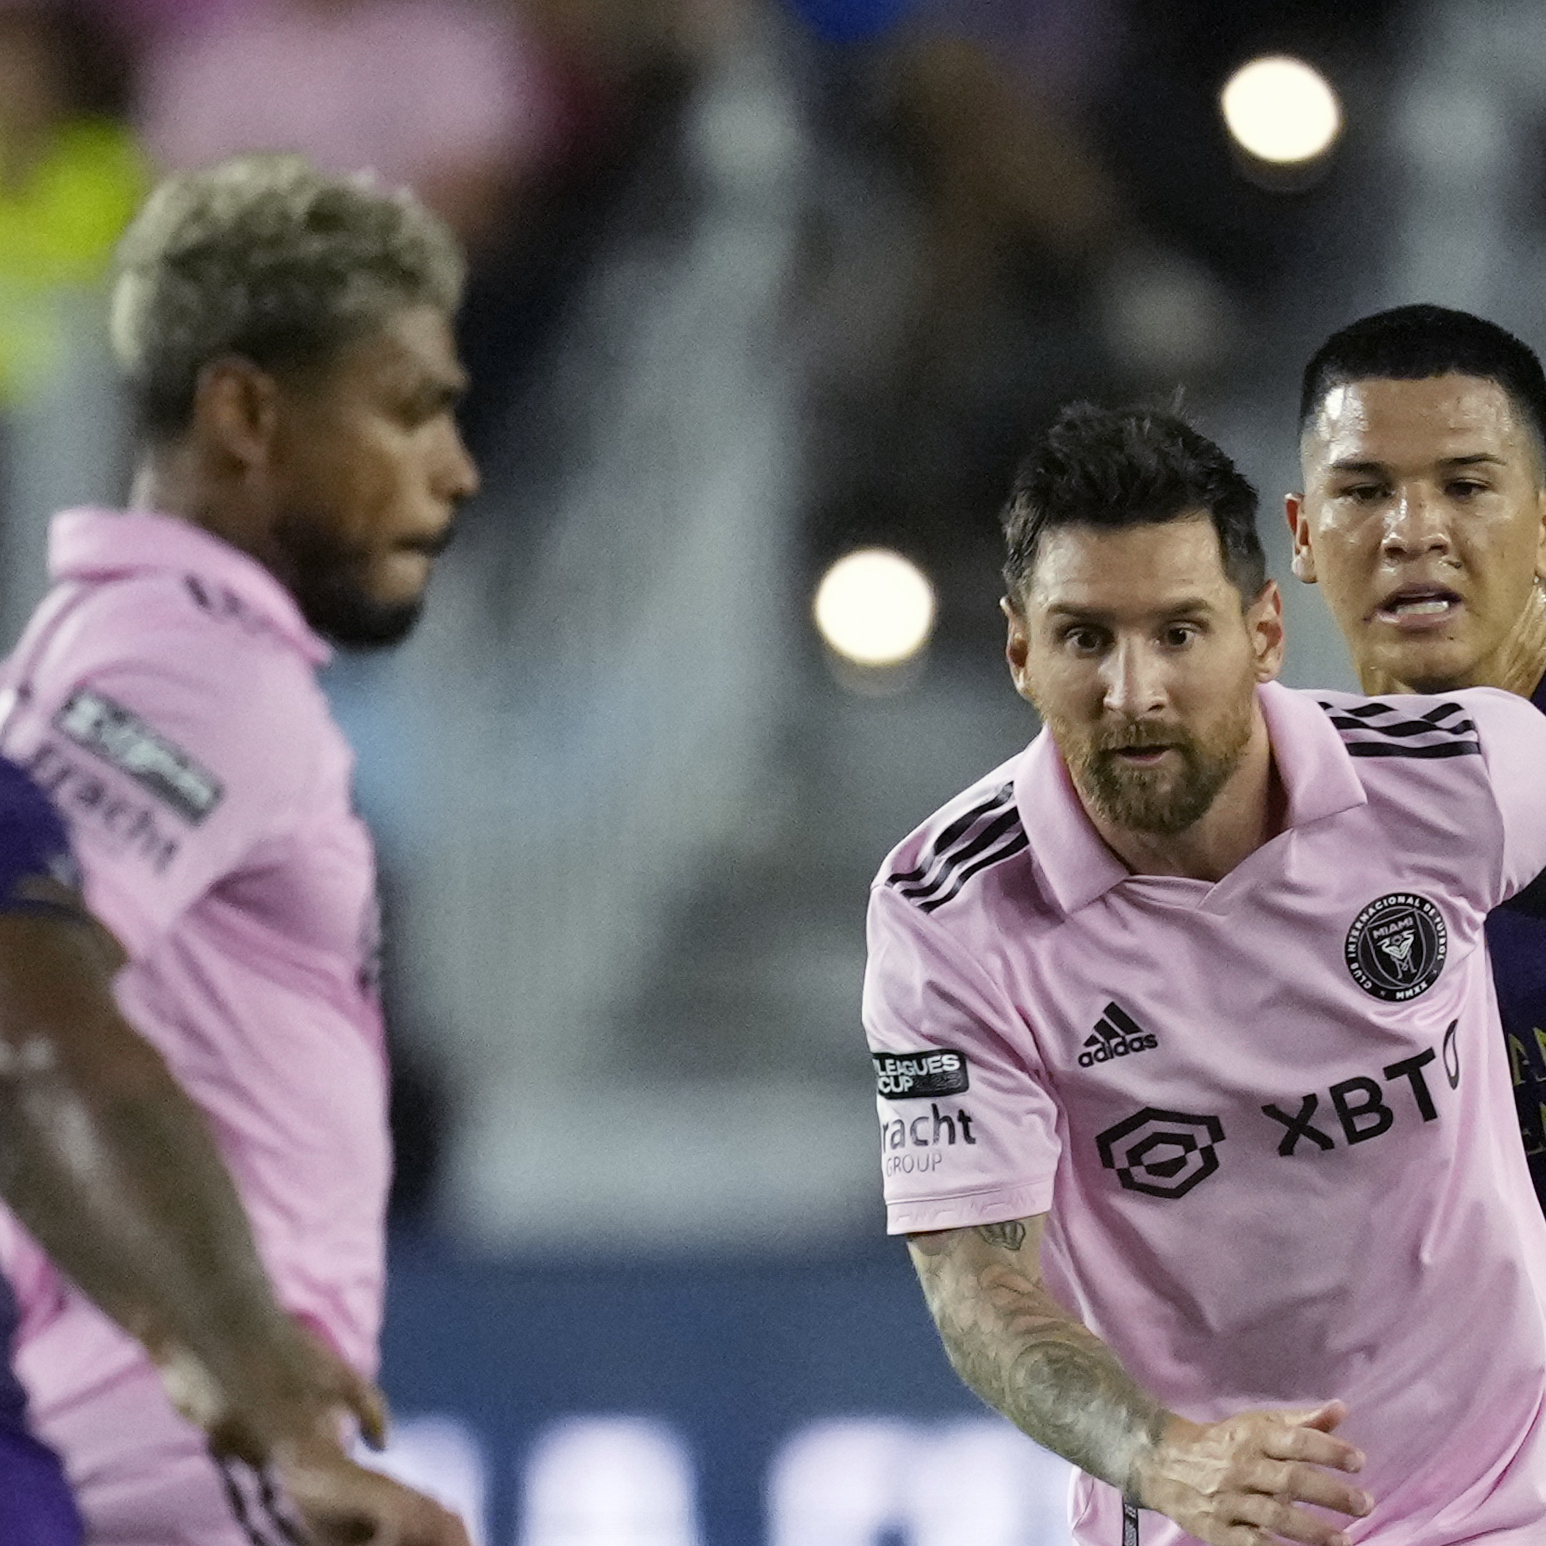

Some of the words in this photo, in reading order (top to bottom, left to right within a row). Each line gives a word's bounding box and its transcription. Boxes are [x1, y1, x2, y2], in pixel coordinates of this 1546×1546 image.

[1347, 895, 1421, 958] INTERNACIONAL
[1372, 916, 1414, 939] MIAMI
[1349, 962, 1373, 990] CLUB
[1077, 1031, 1159, 1068] adidas
[876, 1054, 961, 1077] LEAGUES
[878, 1075, 914, 1094] CUP
[886, 1153, 943, 1177] GROUP
